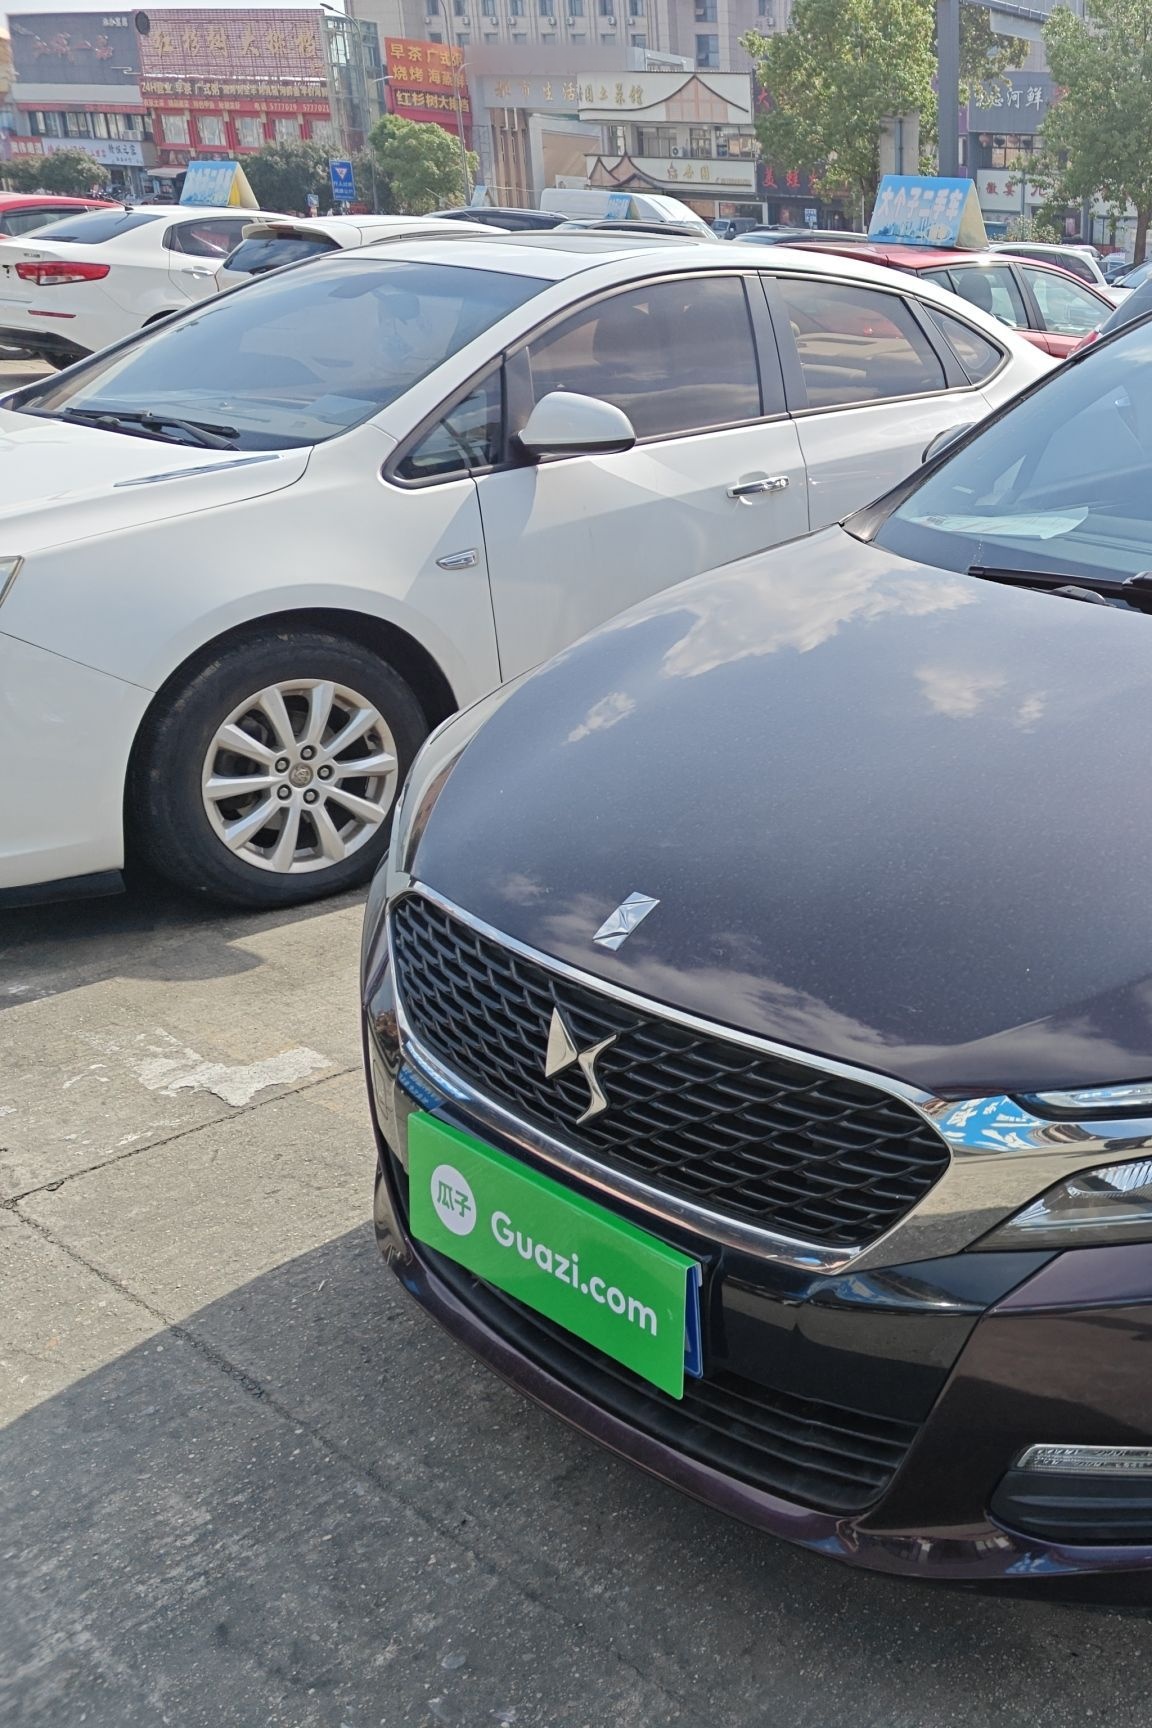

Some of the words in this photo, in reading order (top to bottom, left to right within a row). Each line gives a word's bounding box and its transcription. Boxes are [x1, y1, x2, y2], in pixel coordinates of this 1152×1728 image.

[390, 43, 423, 62] 早茶
[392, 64, 423, 82] 烧烤
[437, 1180, 472, 1218] 瓜子
[490, 1210, 657, 1337] Guazi.com
